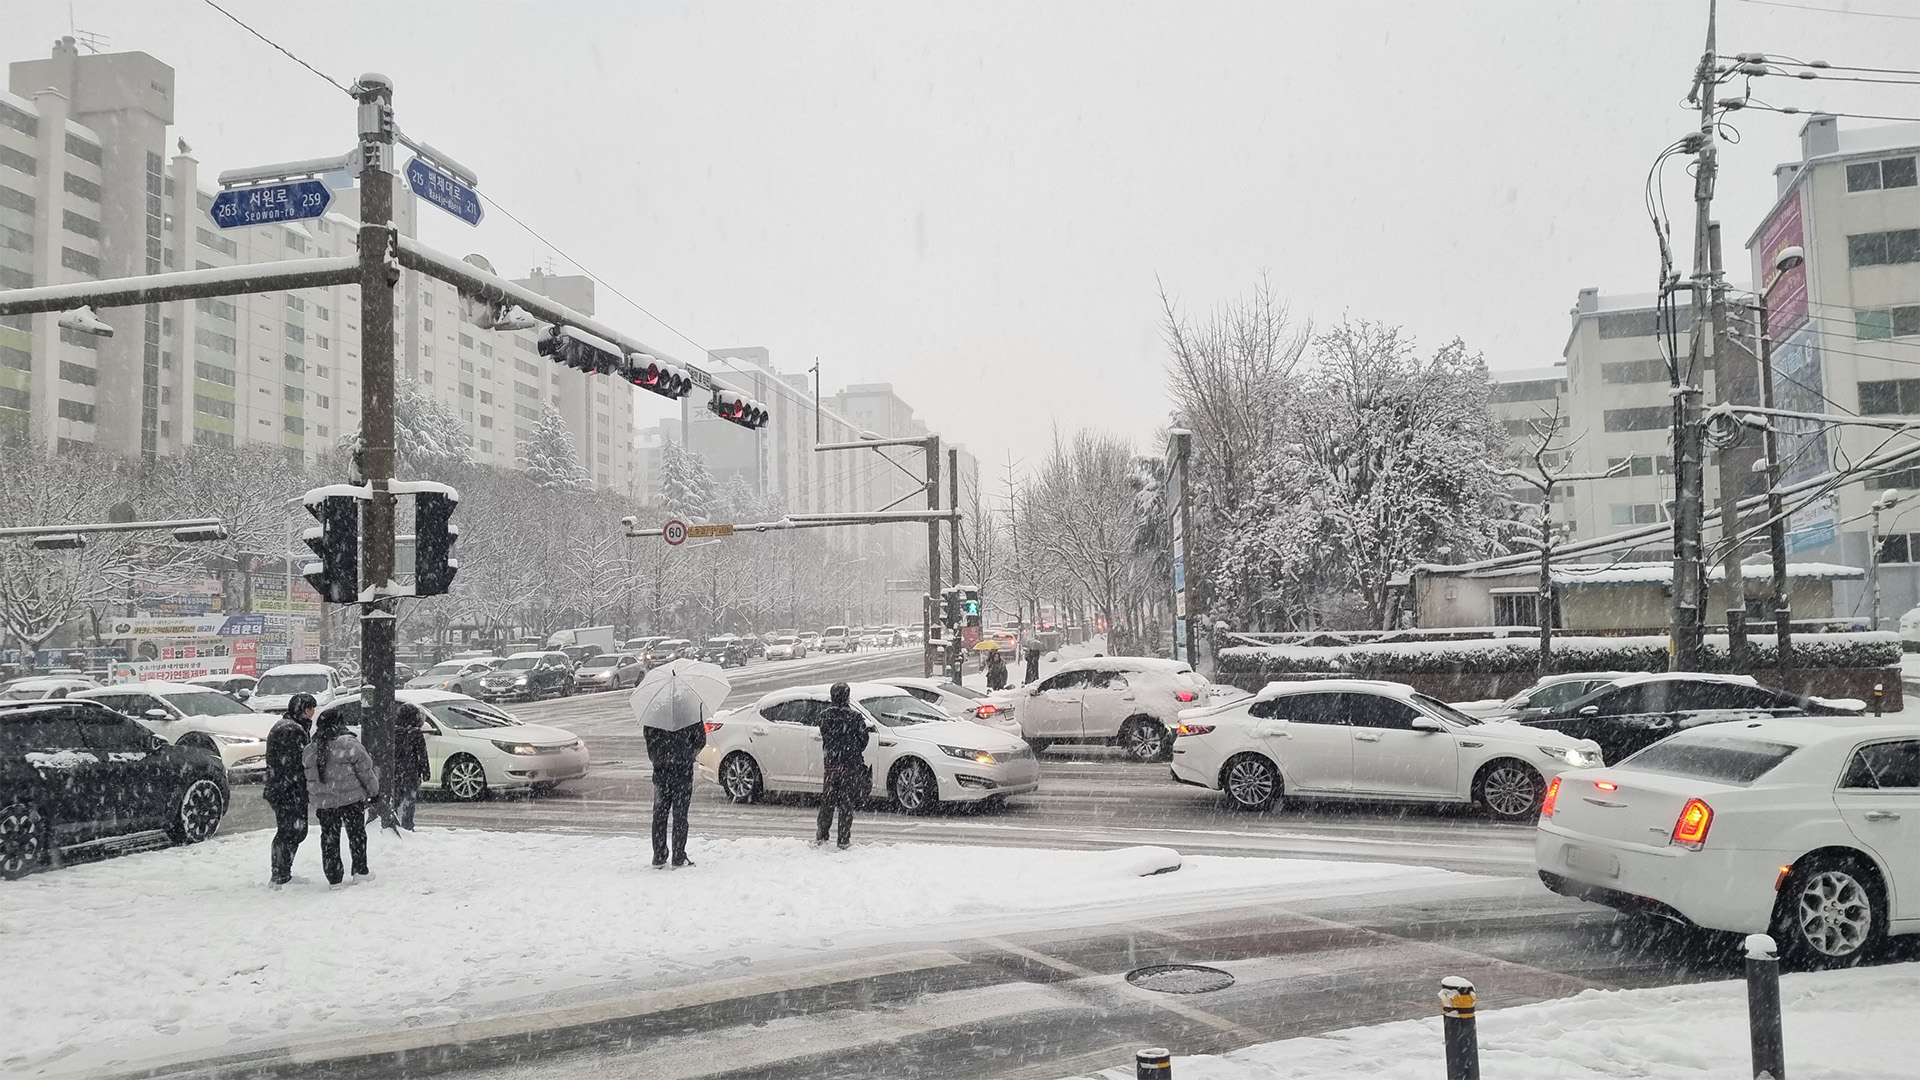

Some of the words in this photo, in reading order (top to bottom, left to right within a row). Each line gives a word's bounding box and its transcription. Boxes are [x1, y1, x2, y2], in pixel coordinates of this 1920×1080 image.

[412, 170, 424, 186] 215
[428, 171, 461, 200] 백제대로
[249, 189, 288, 208] 서원로
[302, 192, 321, 207] 259
[218, 203, 237, 217] 263
[245, 207, 295, 222] Seowon-ro
[668, 527, 681, 538] 60
[231, 624, 262, 635] 김윤덕
